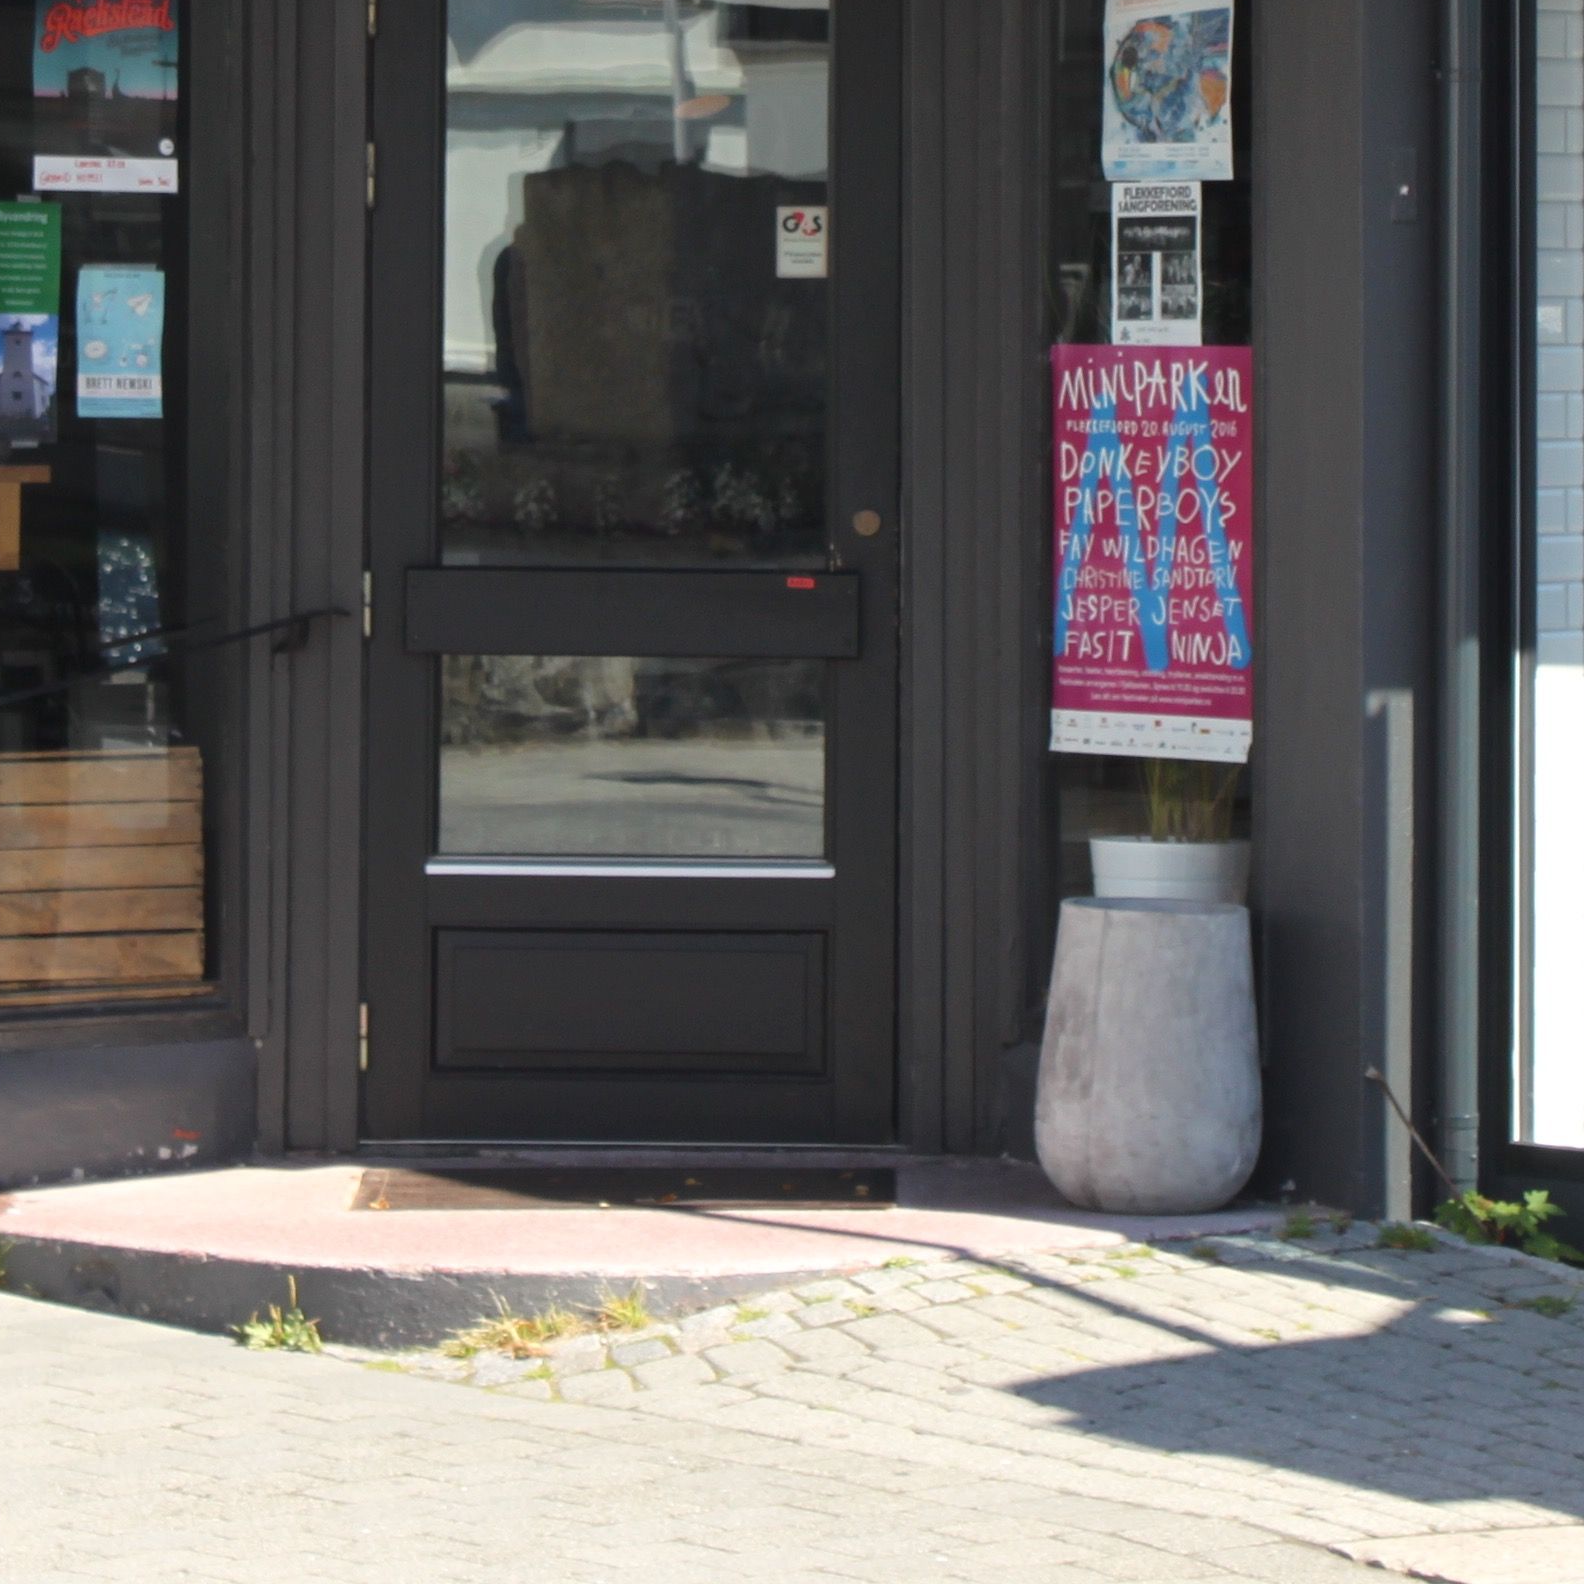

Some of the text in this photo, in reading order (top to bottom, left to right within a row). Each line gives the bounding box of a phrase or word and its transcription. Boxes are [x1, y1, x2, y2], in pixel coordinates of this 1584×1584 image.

[1124, 185, 1192, 199] FLEKKEFJORD
[1118, 199, 1197, 213] SANGFORENING
[85, 377, 113, 390] BRETT
[1210, 419, 1237, 438] 2016
[1064, 485, 1236, 533] PAPERBOYS
[1059, 528, 1242, 565] FAY WILDHAGEN
[1064, 565, 1237, 591] CHRISTINE SANDTORV
[1062, 594, 1242, 625] JESPER JENSET
[1063, 630, 1243, 665] FASIT NINJA
